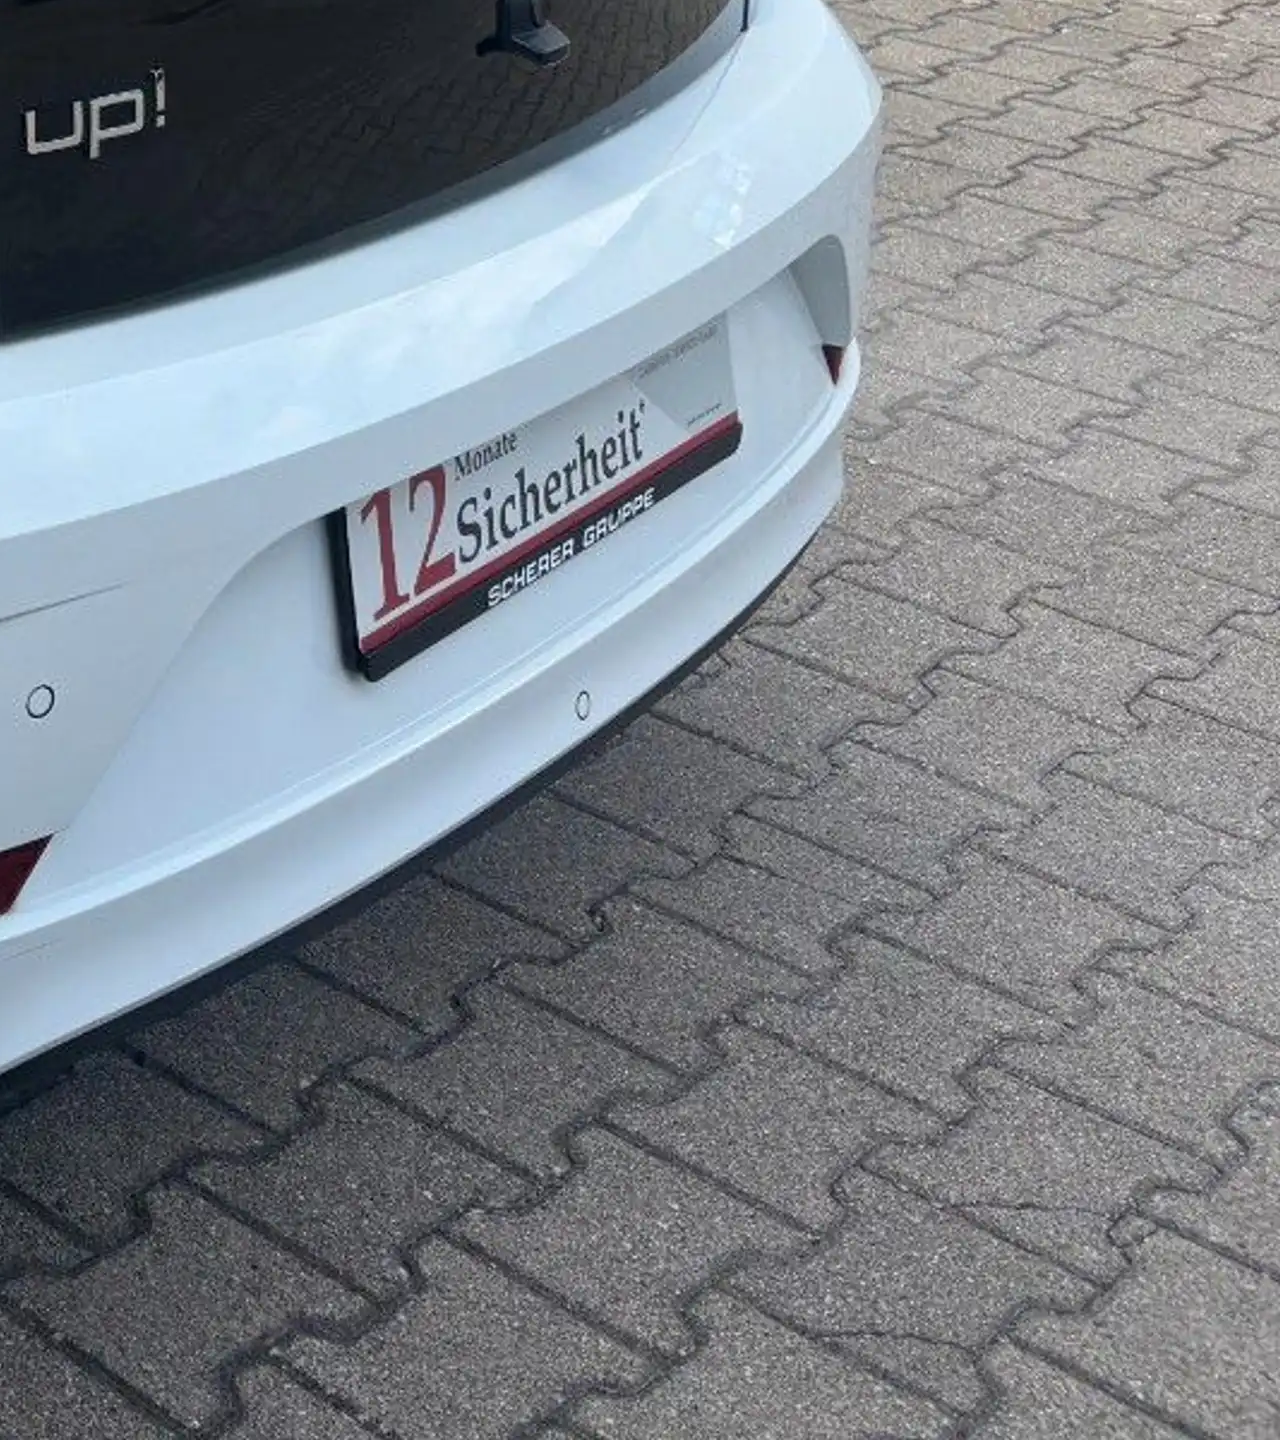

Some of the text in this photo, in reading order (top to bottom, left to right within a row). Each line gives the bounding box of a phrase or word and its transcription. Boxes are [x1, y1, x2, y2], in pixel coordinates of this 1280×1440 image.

[25, 67, 166, 160] up!
[453, 432, 518, 481] Monate
[360, 464, 456, 621] 12
[487, 486, 656, 607] SCHERER GRUPPE
